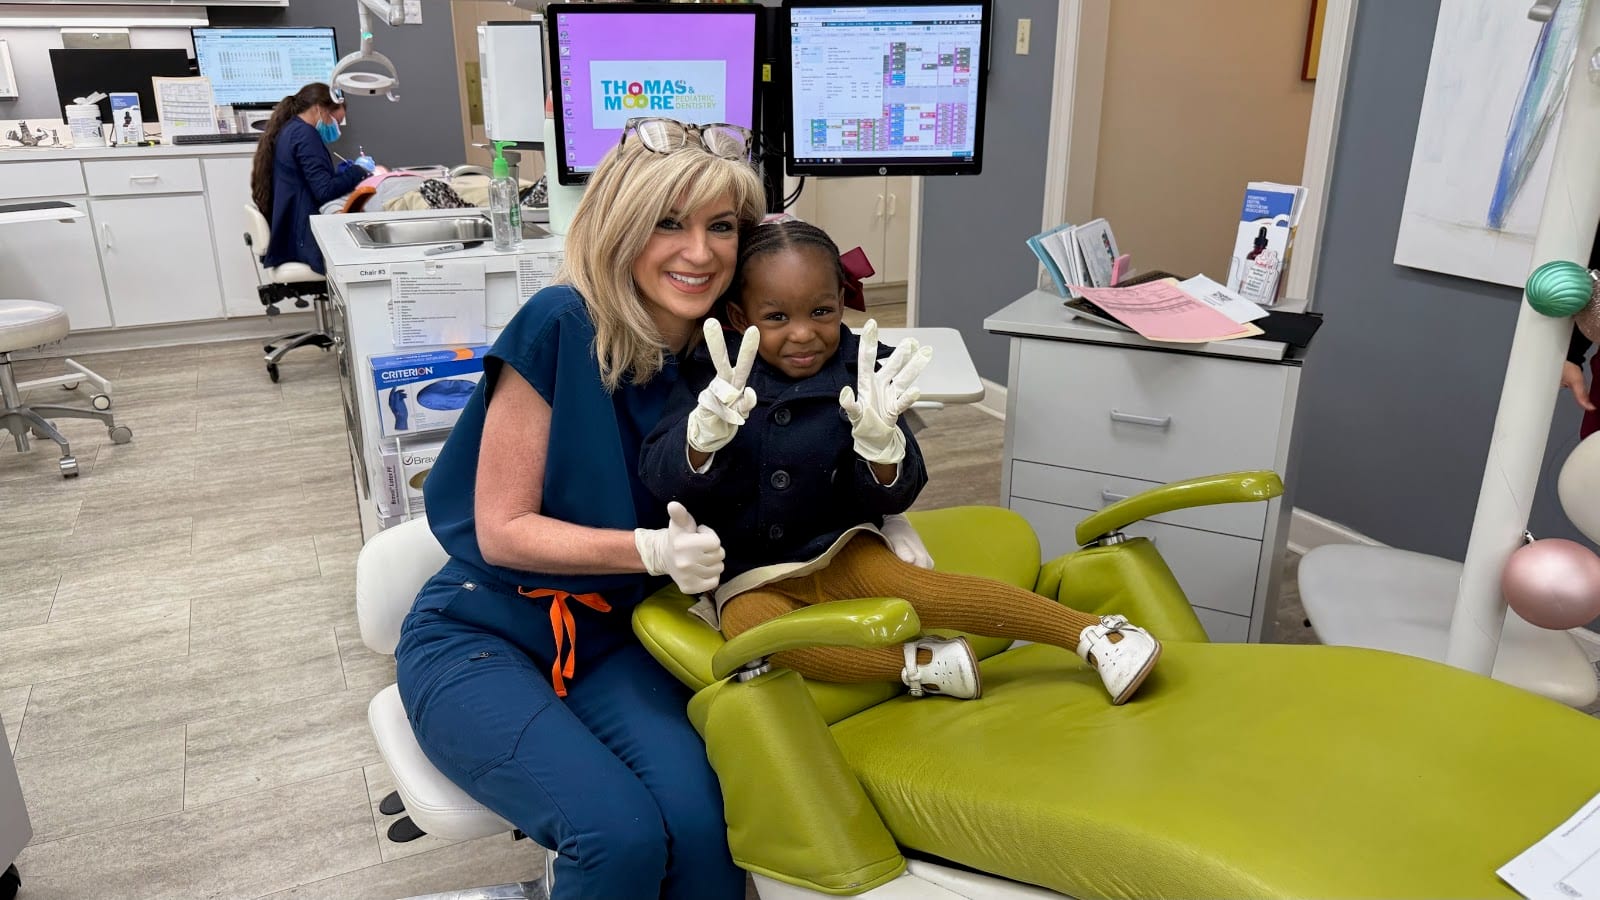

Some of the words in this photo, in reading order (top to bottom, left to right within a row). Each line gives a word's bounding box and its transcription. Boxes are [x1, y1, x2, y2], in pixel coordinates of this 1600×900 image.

[601, 80, 687, 96] THOMAS
[688, 86, 694, 94] &
[604, 94, 674, 110] MOORE
[381, 367, 434, 380] CRITERION
[414, 456, 437, 465] Brav
